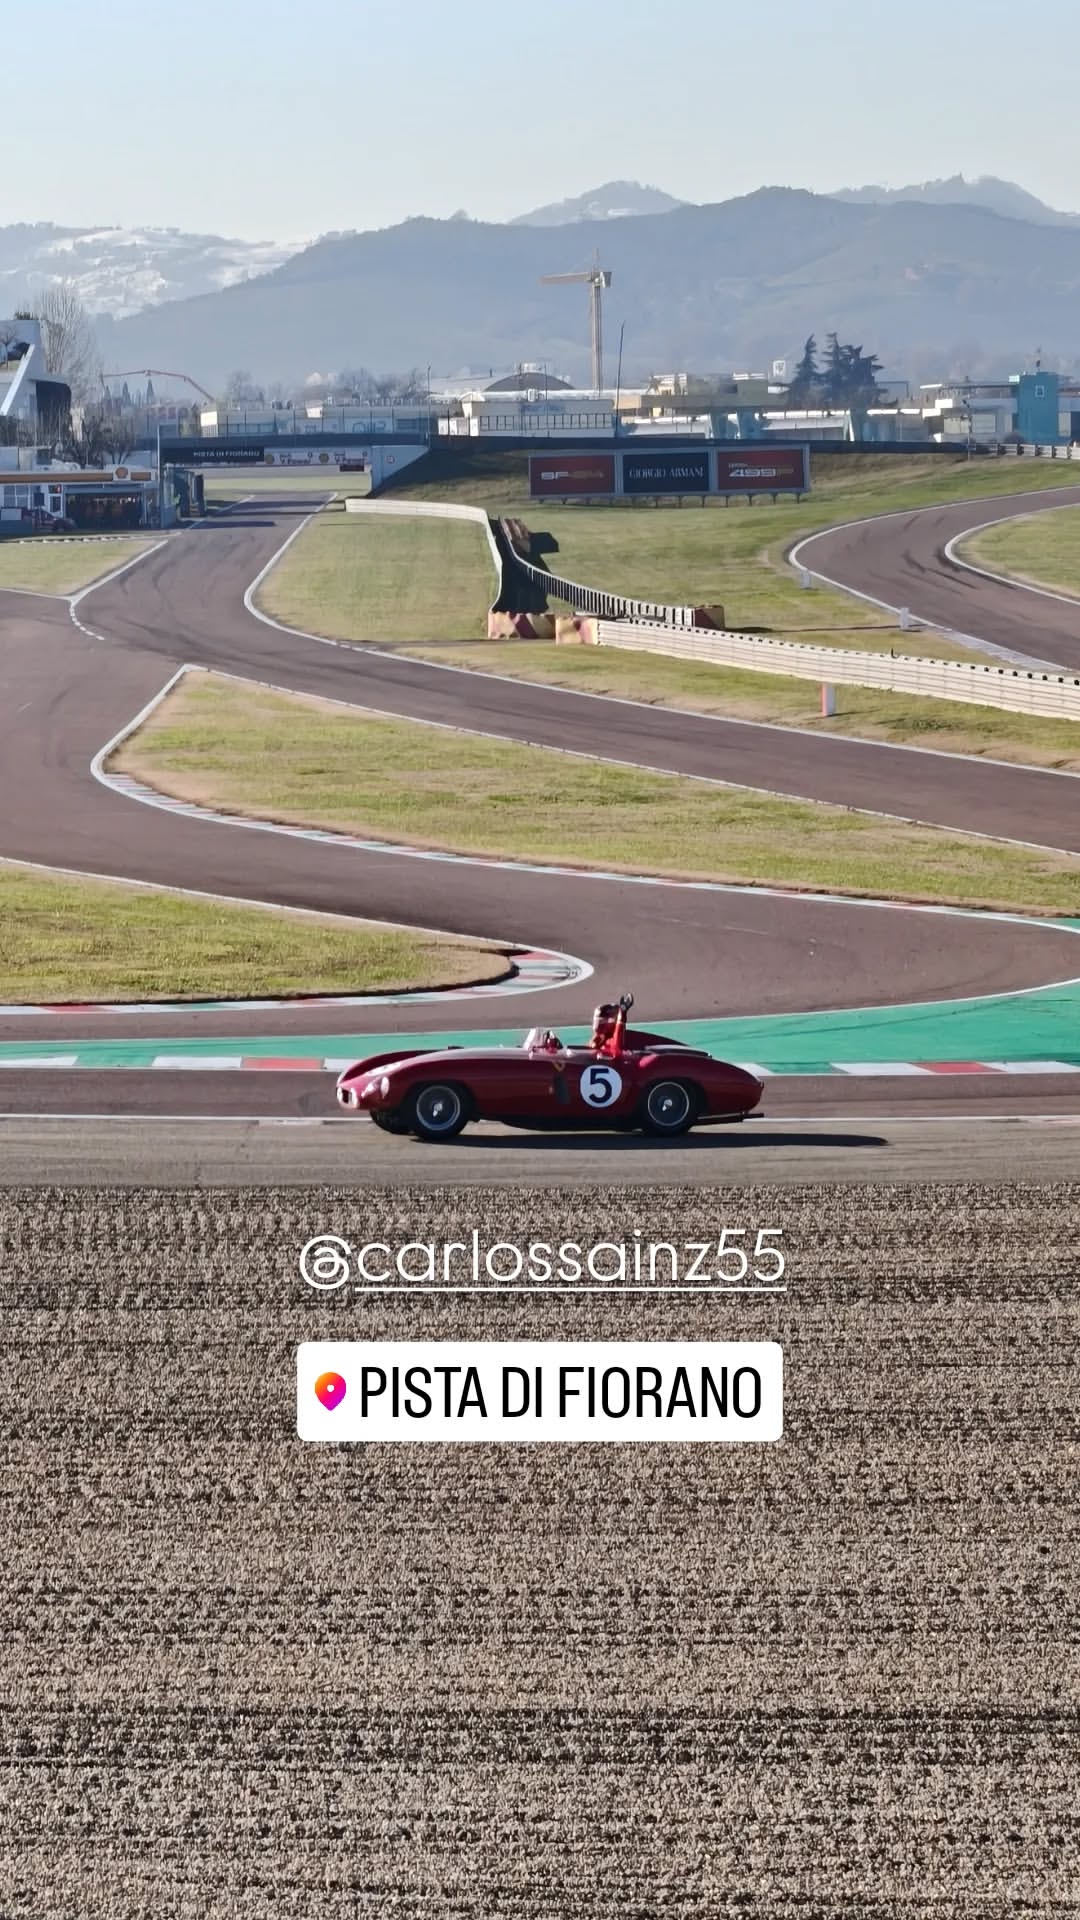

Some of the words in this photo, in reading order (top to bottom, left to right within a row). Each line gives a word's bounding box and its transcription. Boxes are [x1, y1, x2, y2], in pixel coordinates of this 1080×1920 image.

[629, 467, 666, 478] GIORGIO
[671, 466, 704, 478] ARMANI
[589, 1068, 613, 1104] 5
